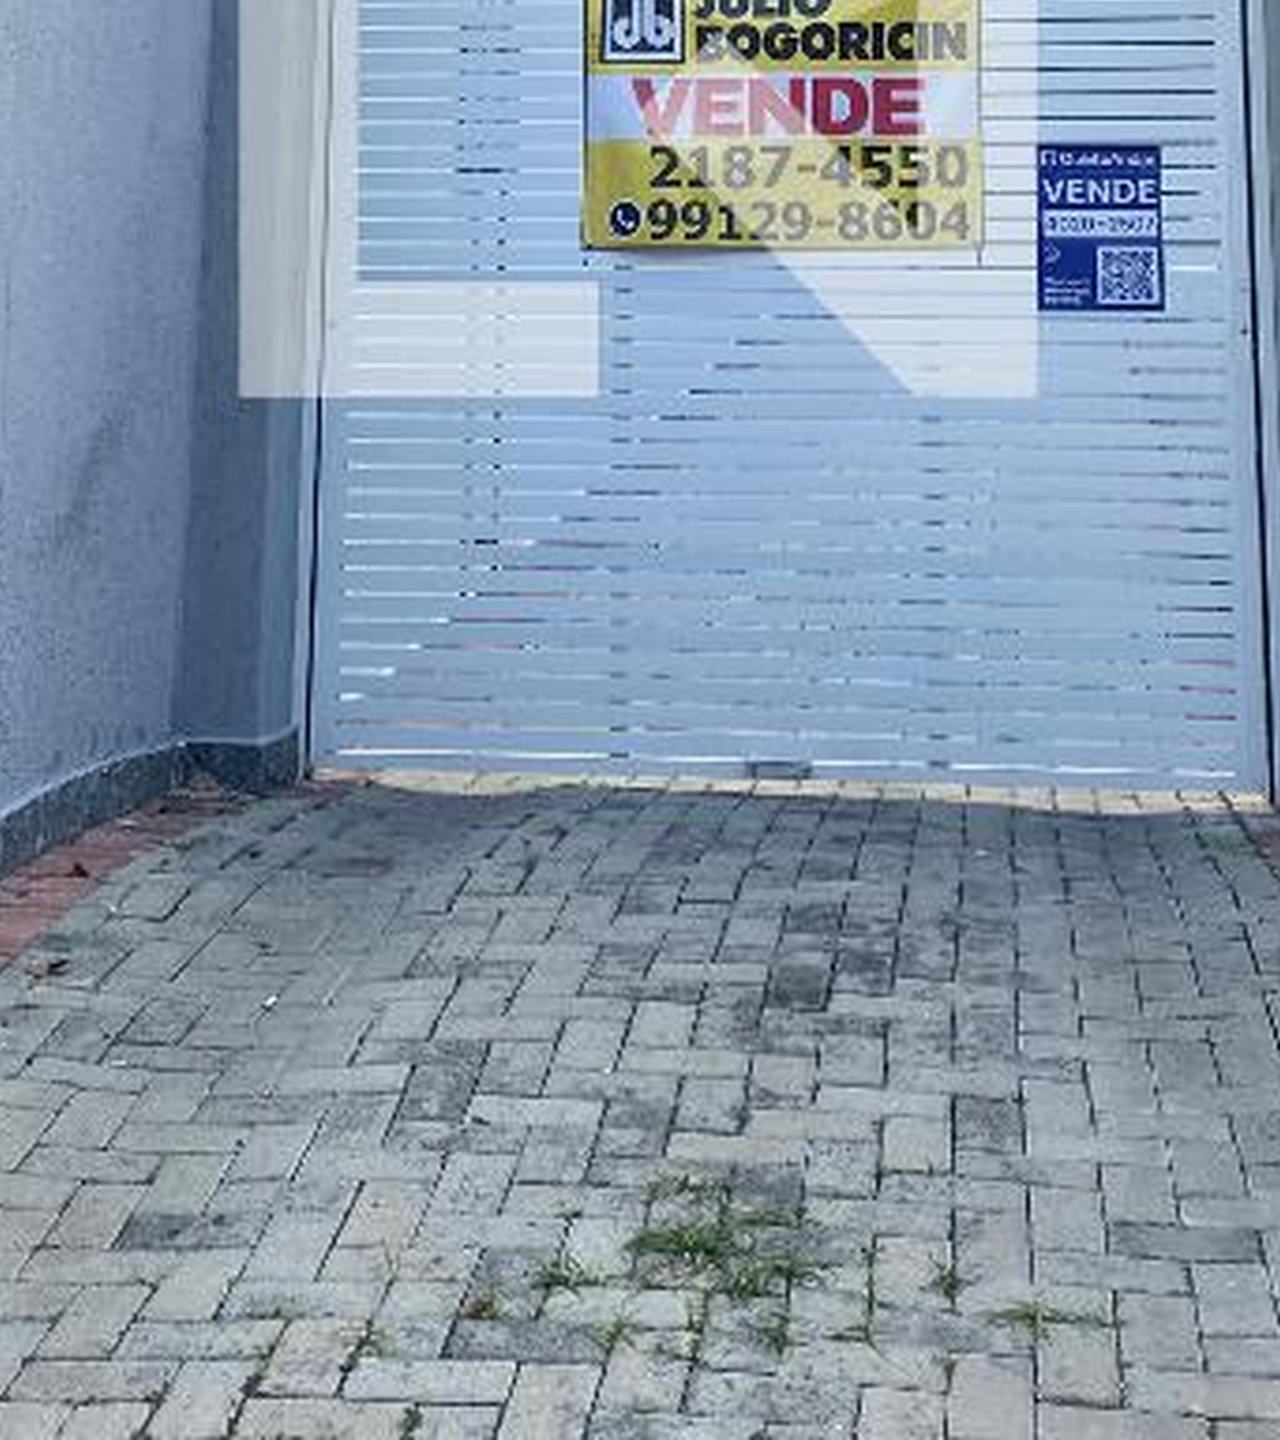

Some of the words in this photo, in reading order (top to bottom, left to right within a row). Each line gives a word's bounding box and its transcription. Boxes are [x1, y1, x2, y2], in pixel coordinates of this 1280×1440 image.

[696, 22, 967, 61] BOGORICIN
[632, 77, 926, 137] VENDE
[649, 145, 969, 189] 2187-4550
[1042, 178, 1158, 204] VENDE
[647, 201, 970, 241] 99129-8604
